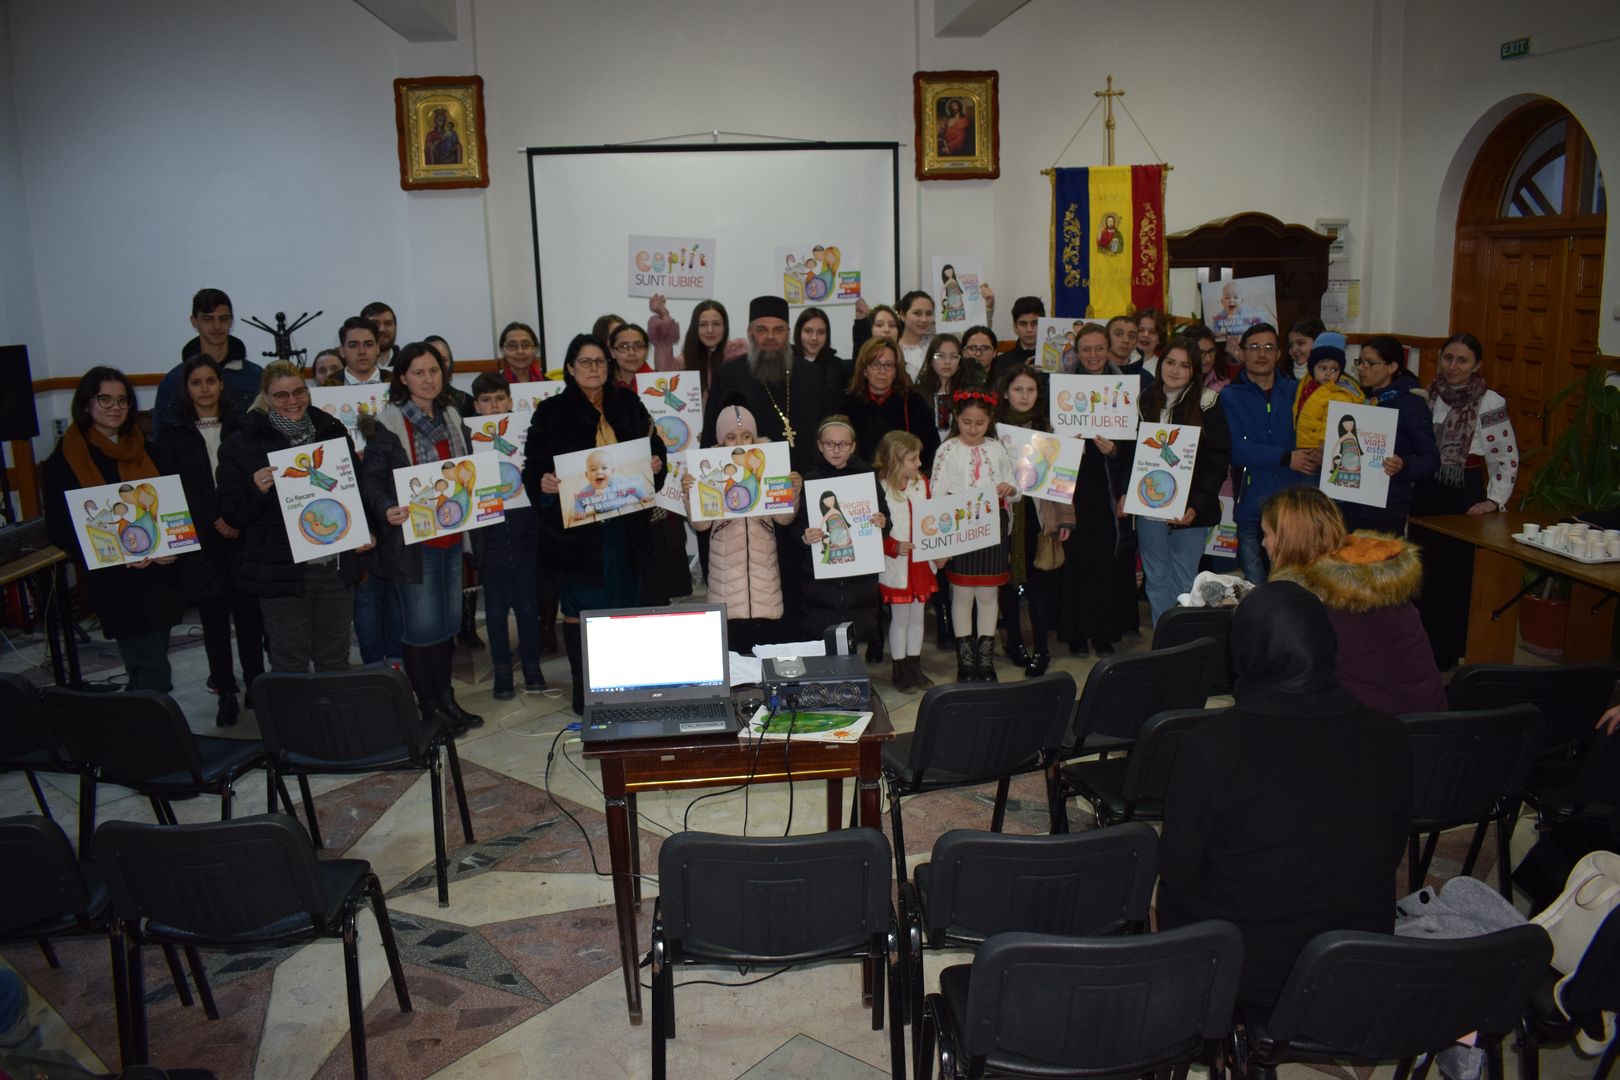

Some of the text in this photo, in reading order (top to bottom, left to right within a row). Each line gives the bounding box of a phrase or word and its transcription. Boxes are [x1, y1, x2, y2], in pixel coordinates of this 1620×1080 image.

[1502, 40, 1527, 57] EXIT
[635, 273, 704, 288] SUNT IUBIRE
[1057, 413, 1128, 427] SUNT IUBIRE
[285, 492, 315, 504] Cu fiecare
[659, 486, 684, 501] UBIR
[921, 524, 991, 551] SUNT IUBIRE
